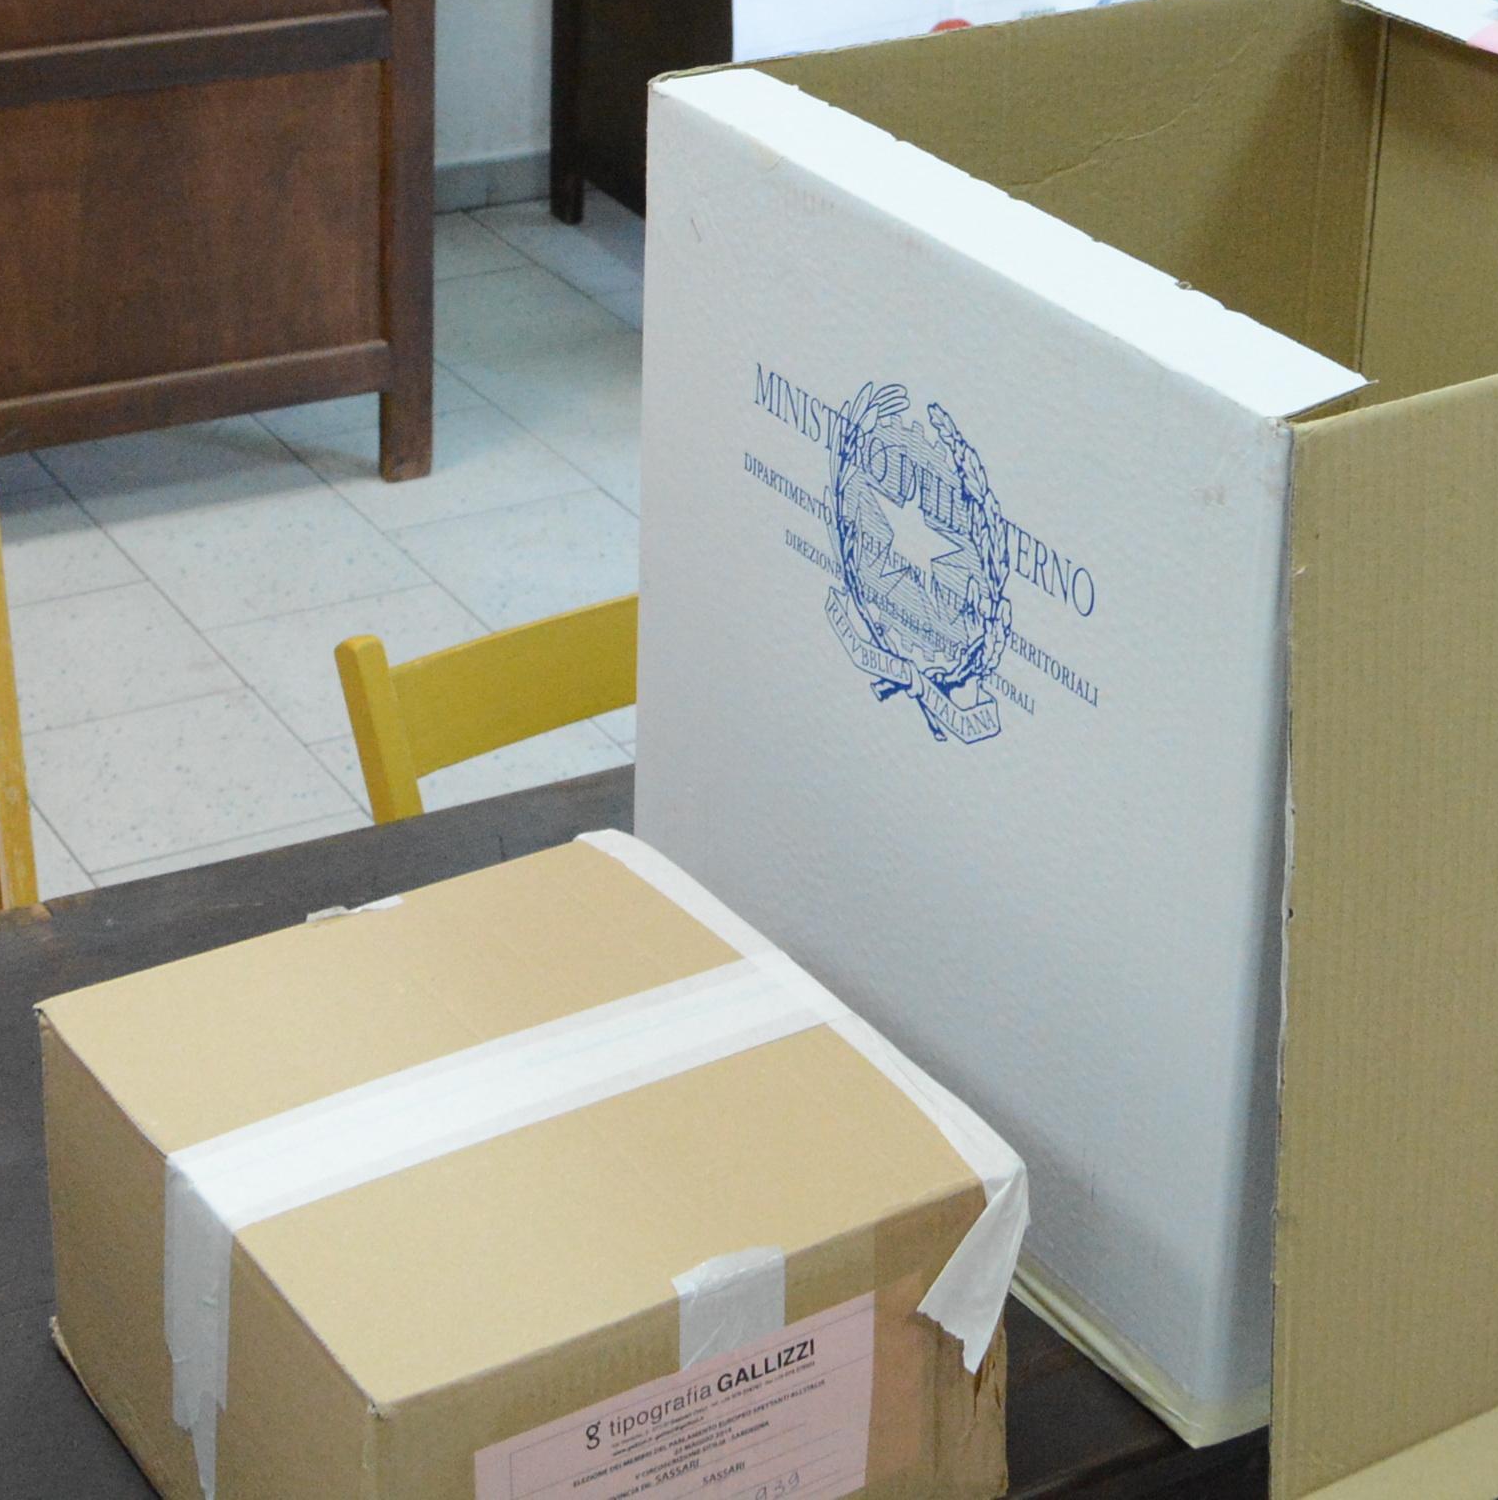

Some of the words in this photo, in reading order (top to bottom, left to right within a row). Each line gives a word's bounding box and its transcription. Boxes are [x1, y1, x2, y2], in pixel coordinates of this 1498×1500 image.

[744, 452, 834, 526] DIPARTIMENTO
[1008, 631, 1099, 708] ERRITORIALI
[609, 1384, 710, 1436] tipografia
[716, 1337, 814, 1393] GALLIZZI
[655, 1458, 699, 1485] SASSARI
[702, 1461, 745, 1486] SASSARI
